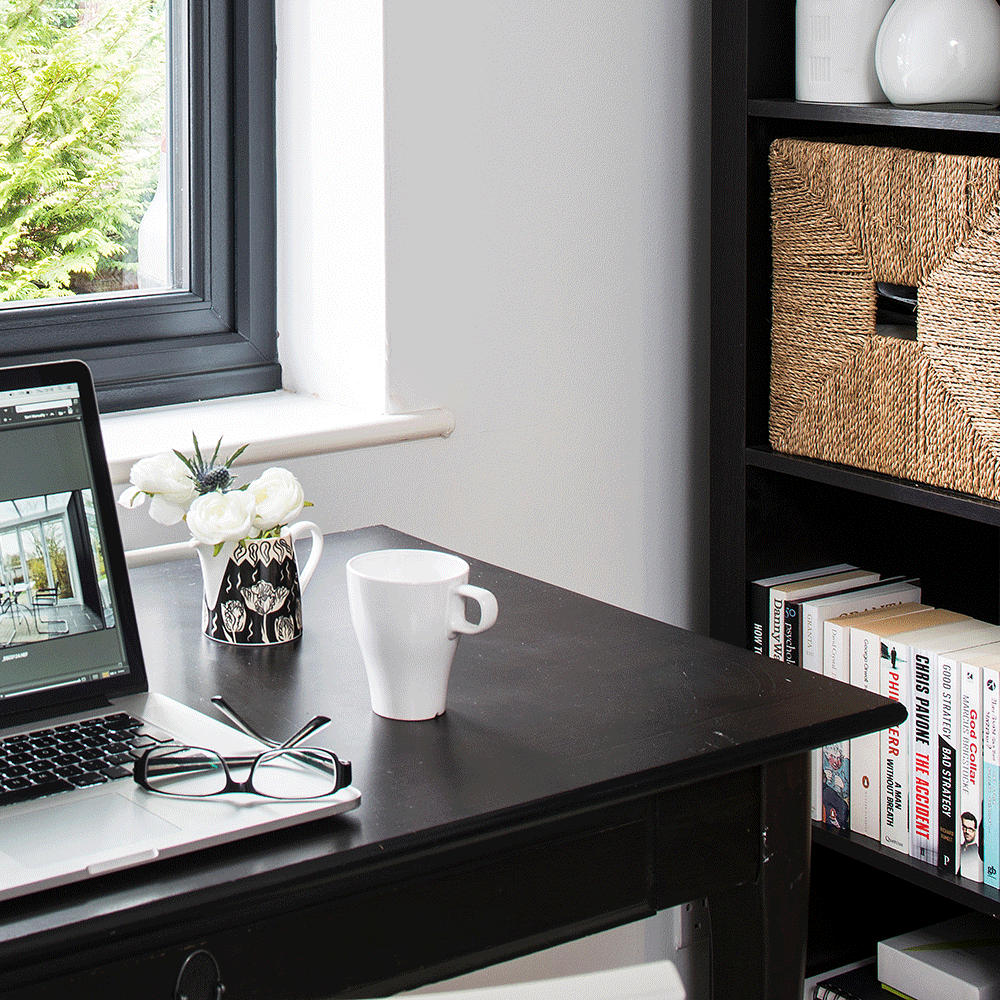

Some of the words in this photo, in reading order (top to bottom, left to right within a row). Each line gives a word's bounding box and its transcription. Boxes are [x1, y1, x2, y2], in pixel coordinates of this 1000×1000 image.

[754, 623, 763, 645] HOW
[771, 598, 783, 643] Danny
[785, 622, 796, 665] psychol
[916, 654, 930, 694] CHRIS
[942, 664, 951, 690] GOOD
[916, 697, 930, 746] PAVONE
[942, 692, 951, 740] STRATEGY
[970, 709, 978, 739] God
[916, 752, 930, 776] THE
[942, 747, 951, 767] BAD
[970, 743, 978, 785] Collar
[886, 759, 894, 796] WITHOUT
[942, 769, 951, 818] STRATEGY
[886, 797, 894, 827] BREATH
[894, 790, 902, 810] MAN
[916, 777, 930, 840] ACCIDENT
[943, 855, 950, 866] P
